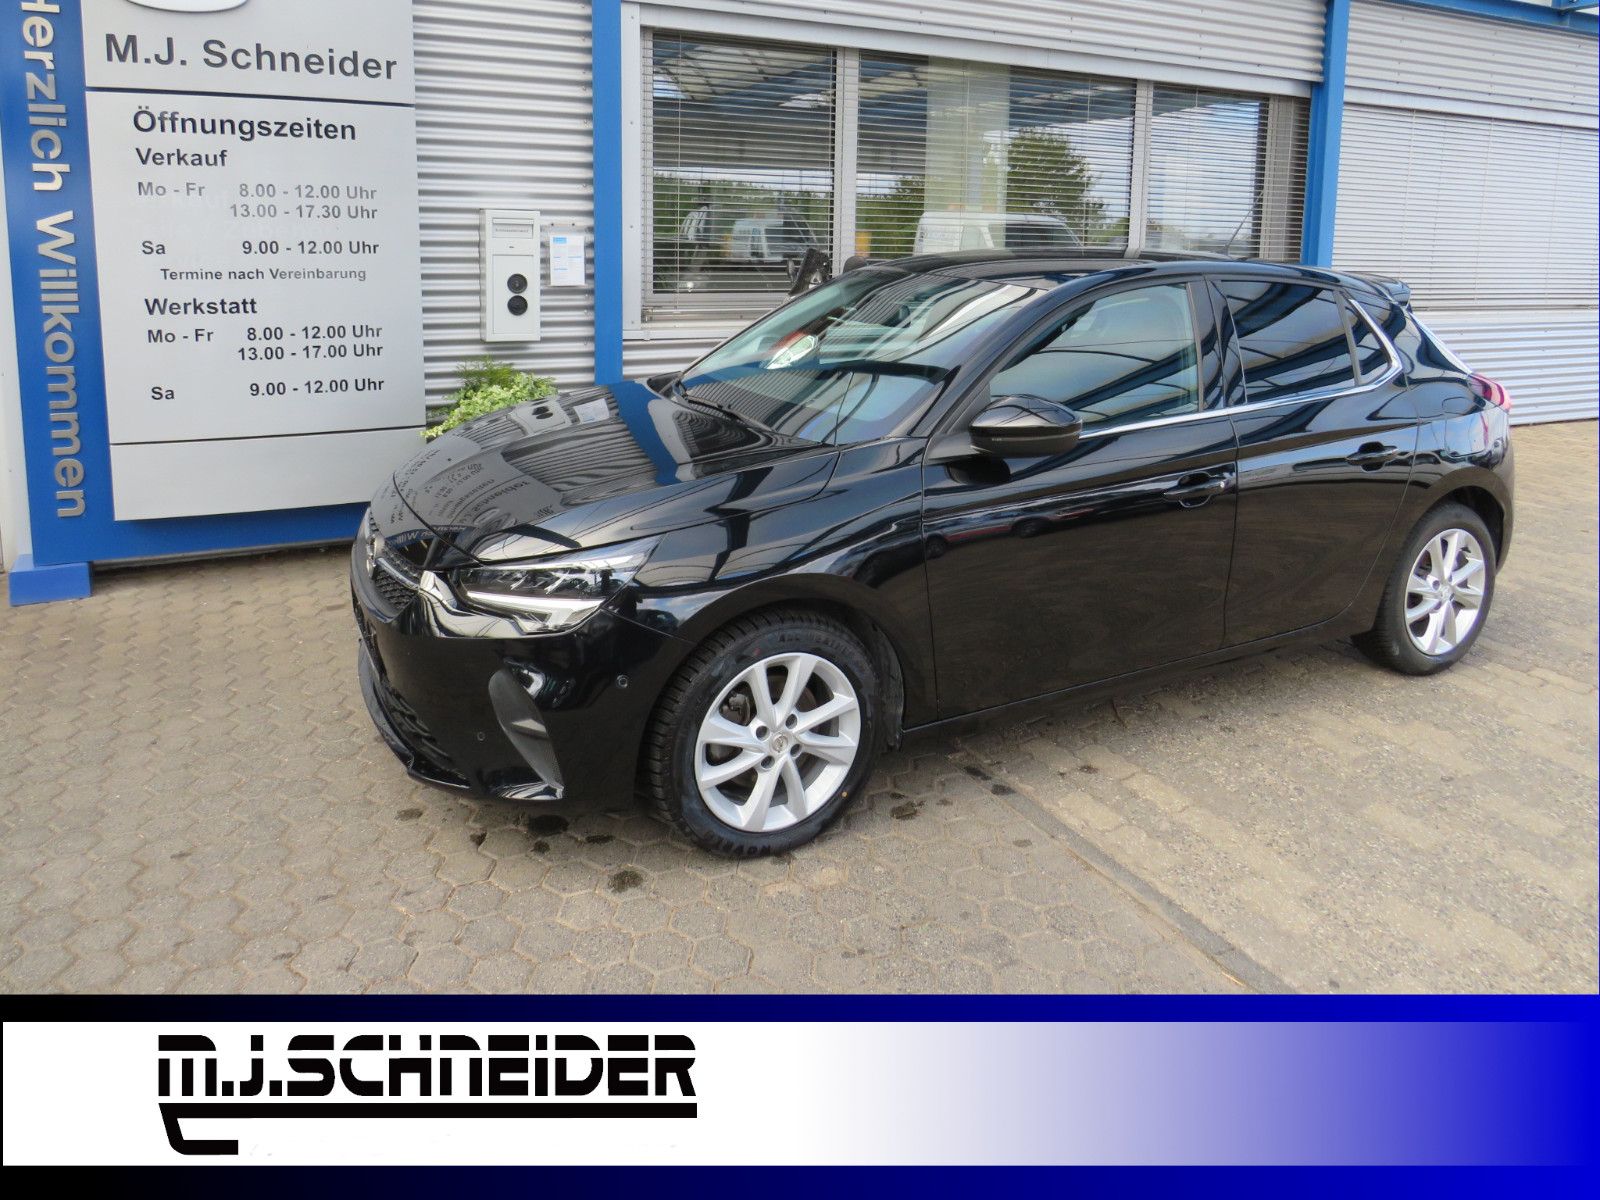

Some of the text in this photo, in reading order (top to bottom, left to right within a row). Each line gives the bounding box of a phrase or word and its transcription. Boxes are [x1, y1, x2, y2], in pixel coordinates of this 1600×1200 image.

[105, 33, 398, 80] M.J. Schneider
[132, 105, 357, 142] Öffnungszeiten
[135, 147, 228, 167] Verkauf
[137, 181, 167, 197] Mo
[185, 181, 206, 197] Fr
[239, 183, 277, 198] 8.00
[294, 184, 341, 199] 12.00
[346, 185, 378, 200] Uhr
[229, 203, 278, 218] 13.00
[295, 204, 342, 219] 17.30
[347, 205, 378, 220] Uhr
[141, 240, 166, 255] Sa
[242, 240, 280, 255] 9.00
[297, 240, 343, 255] 12.00
[348, 240, 380, 255] Uhr
[159, 267, 367, 282] Termine nach Vereinbarung
[144, 297, 258, 316] Werkstatt
[147, 329, 176, 344] Mo
[194, 328, 214, 343] Fr
[247, 326, 284, 342] 8.00
[301, 325, 347, 340] 12.00
[352, 324, 383, 339] Uhr
[237, 346, 285, 361] 13.00
[302, 344, 348, 359] 17.00
[353, 343, 384, 358] Uhr
[36, 210, 87, 518] Willkommen
[151, 386, 175, 401] Sa
[249, 381, 287, 397] 9.00
[304, 378, 349, 394] 12.00
[354, 377, 385, 392] Uhr
